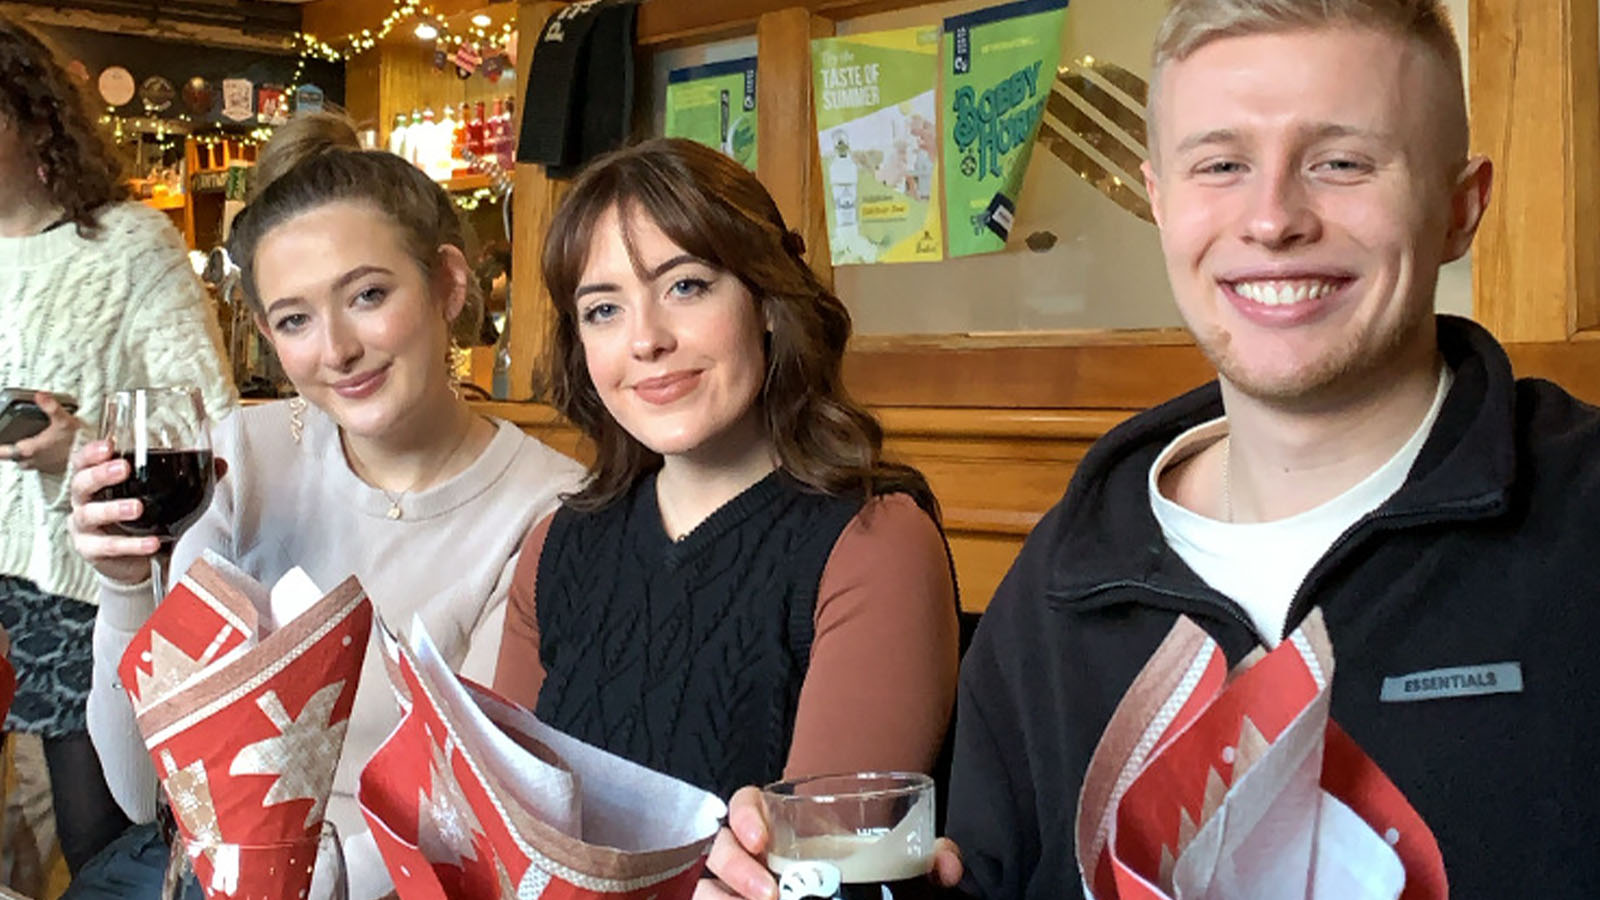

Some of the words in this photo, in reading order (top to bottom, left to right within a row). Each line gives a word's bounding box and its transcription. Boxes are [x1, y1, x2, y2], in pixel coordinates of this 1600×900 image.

[820, 65, 862, 89] TASTE
[864, 63, 881, 85] OF
[823, 85, 881, 111] SUMMER
[953, 60, 1043, 153] BOBBY
[1404, 672, 1498, 693] ESSENTIALS
